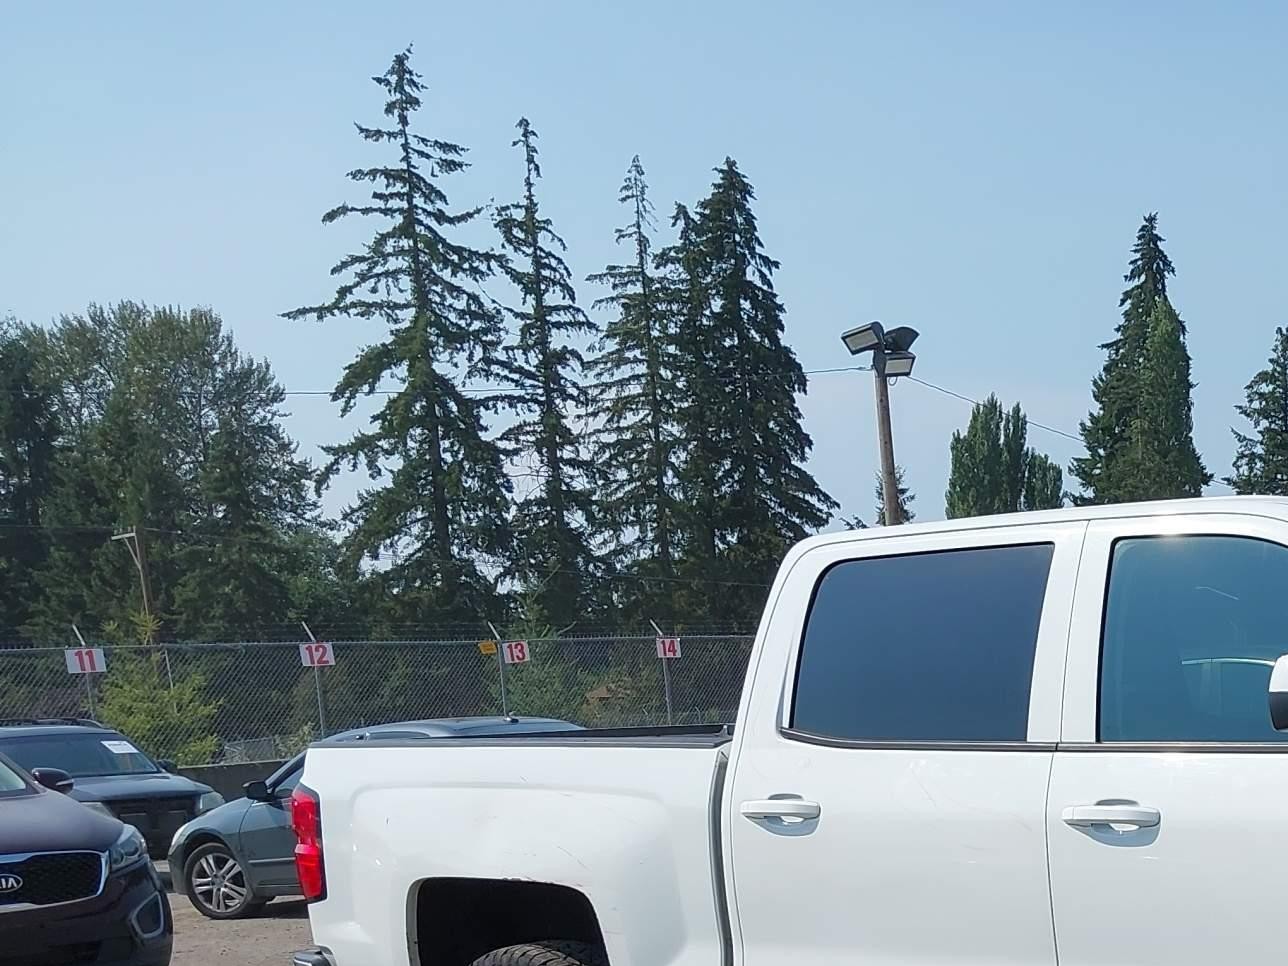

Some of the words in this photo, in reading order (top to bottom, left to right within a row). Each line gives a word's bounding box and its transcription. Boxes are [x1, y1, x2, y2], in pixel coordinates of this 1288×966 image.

[305, 644, 330, 665] 12
[506, 642, 527, 663] 13
[660, 639, 678, 657] 14
[75, 649, 97, 672] 11
[0, 877, 18, 889] IA
